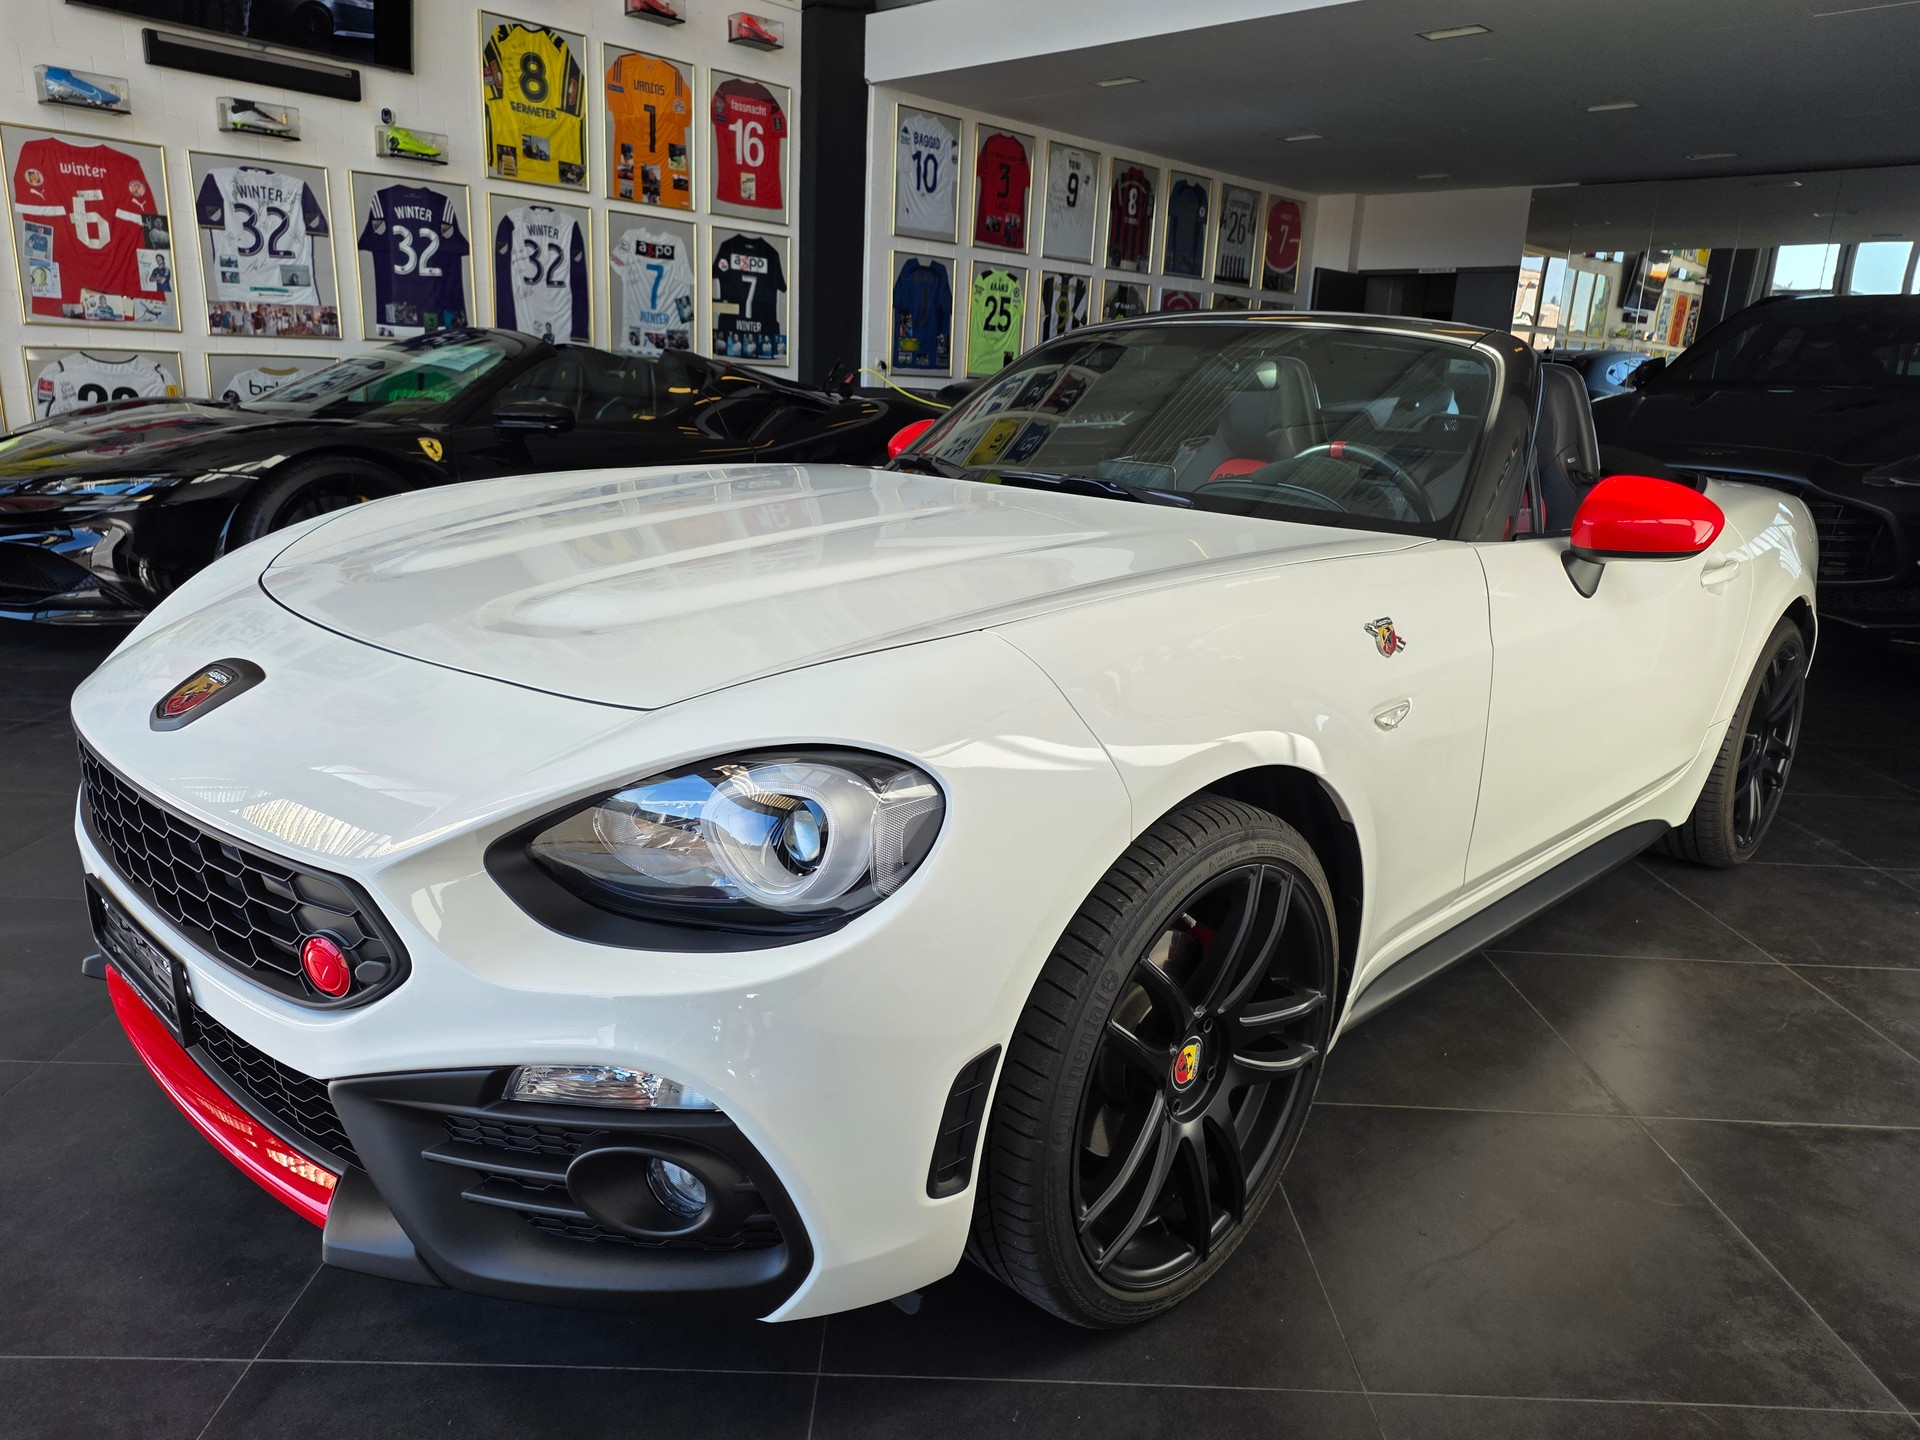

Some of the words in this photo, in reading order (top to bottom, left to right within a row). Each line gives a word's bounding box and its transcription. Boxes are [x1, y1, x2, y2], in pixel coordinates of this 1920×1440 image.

[519, 51, 549, 103] 8
[510, 100, 557, 120] SERMETER
[730, 99, 767, 117] fassnacht
[643, 103, 657, 153] 1
[728, 118, 765, 168] 16
[913, 132, 941, 150] BAGGIO
[59, 161, 107, 178] winter
[912, 150, 938, 194] 10
[997, 162, 1011, 199] 3
[235, 184, 283, 203] WINTER
[1066, 172, 1079, 208] 9
[1127, 187, 1138, 216] 8
[69, 189, 111, 250] 6
[234, 203, 296, 259] 32
[394, 206, 433, 223] WINTER
[527, 224, 560, 240] WINTER
[1227, 211, 1247, 245] 26
[392, 224, 443, 277] 32
[1278, 224, 1289, 255] 7
[523, 239, 567, 288] 32
[646, 263, 664, 310] 7
[742, 275, 757, 319] 7
[640, 310, 669, 325] WINTER
[736, 320, 762, 333] WINTER
[983, 295, 1011, 333] 25
[1055, 296, 1069, 330] 9
